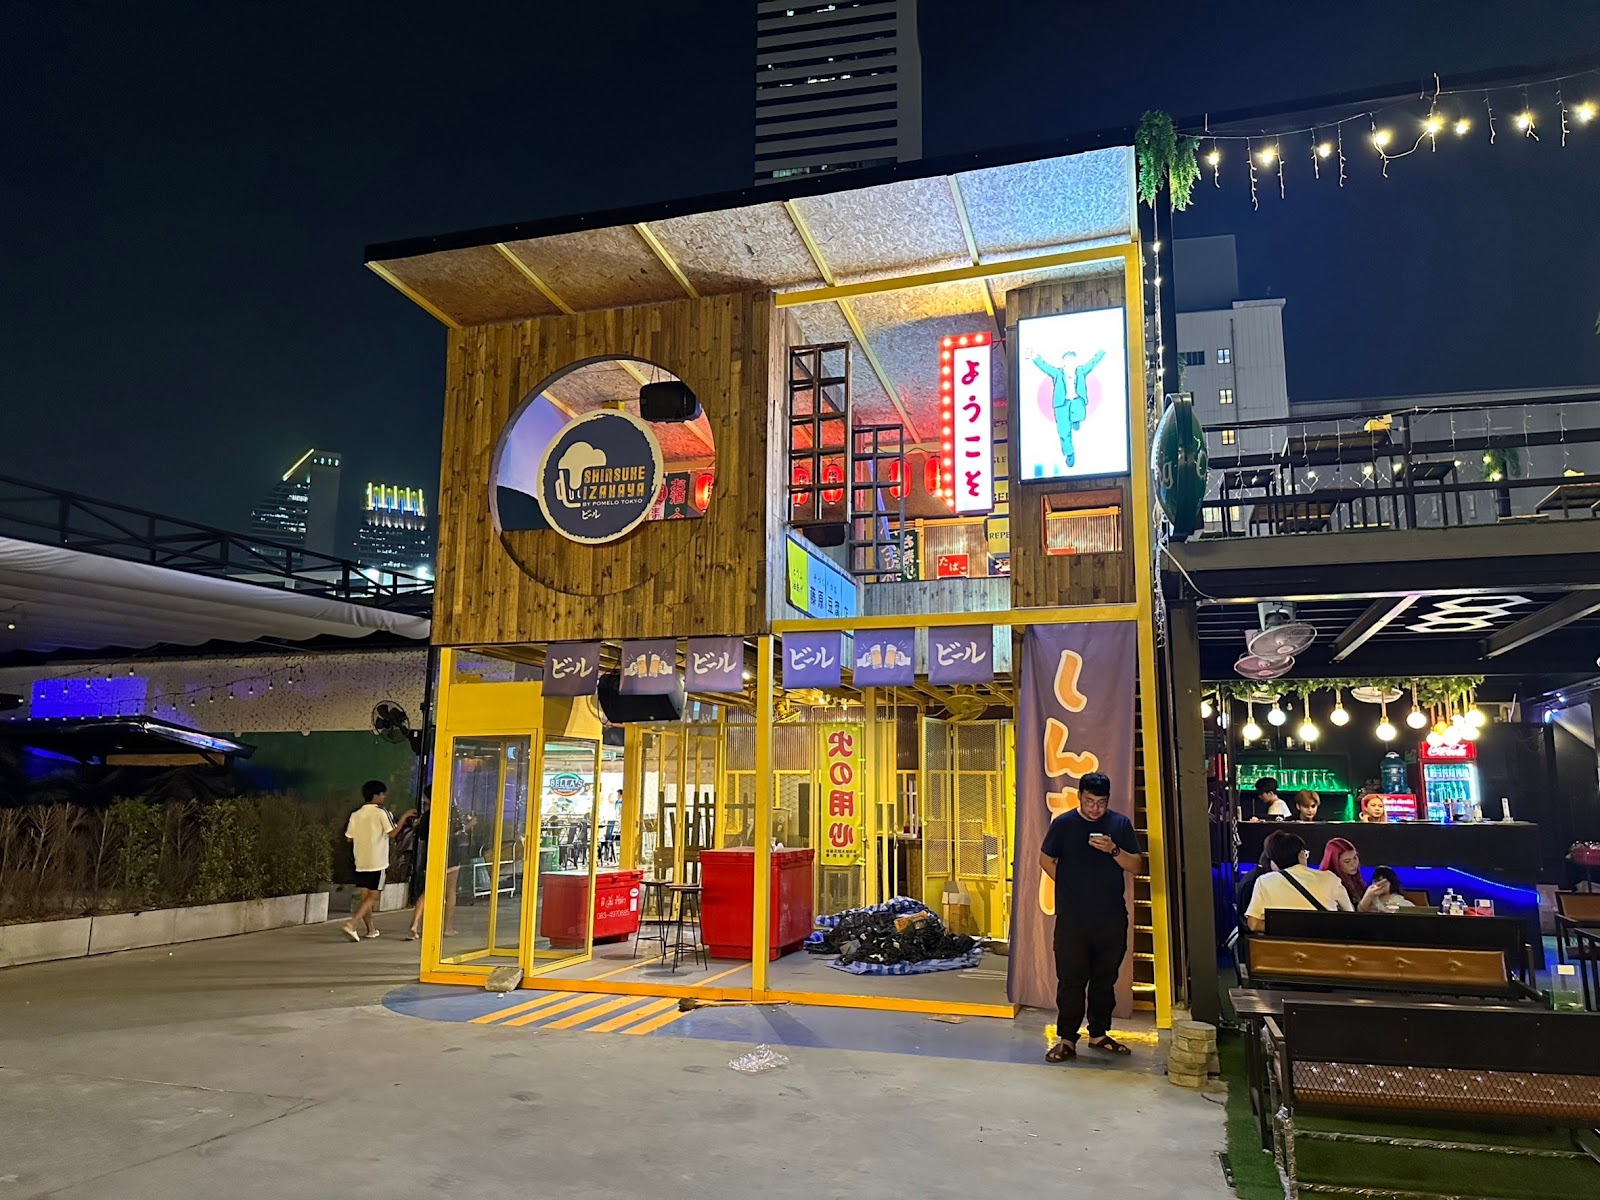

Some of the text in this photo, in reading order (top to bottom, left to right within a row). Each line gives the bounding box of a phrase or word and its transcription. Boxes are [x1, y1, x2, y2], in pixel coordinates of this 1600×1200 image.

[961, 360, 981, 497] ようこそ
[583, 465, 646, 484] SHINSUKE
[582, 482, 645, 500] IZAKAYA
[581, 509, 601, 520] ビール
[939, 556, 968, 575] たばこ
[693, 651, 737, 675] ビール
[789, 646, 834, 671] ビール
[936, 641, 986, 667] ビール
[552, 657, 593, 679] ビール
[550, 778, 584, 788] BELLA'S
